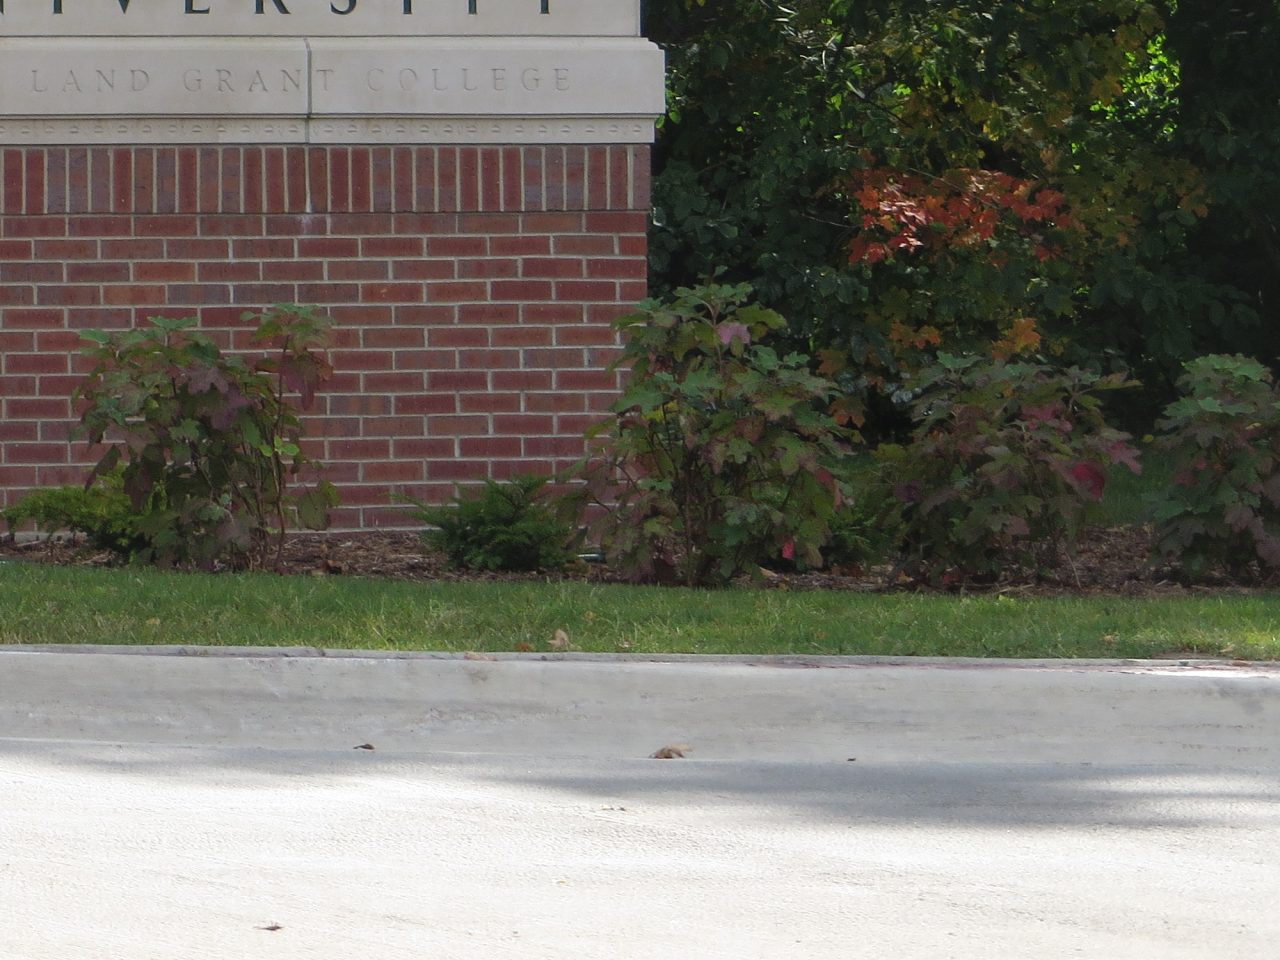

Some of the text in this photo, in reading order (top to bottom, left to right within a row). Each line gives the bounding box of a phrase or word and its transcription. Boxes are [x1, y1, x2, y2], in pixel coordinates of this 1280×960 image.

[31, 68, 150, 93] LAND
[183, 68, 335, 93] GRANT
[367, 67, 571, 92] COLLEGE
